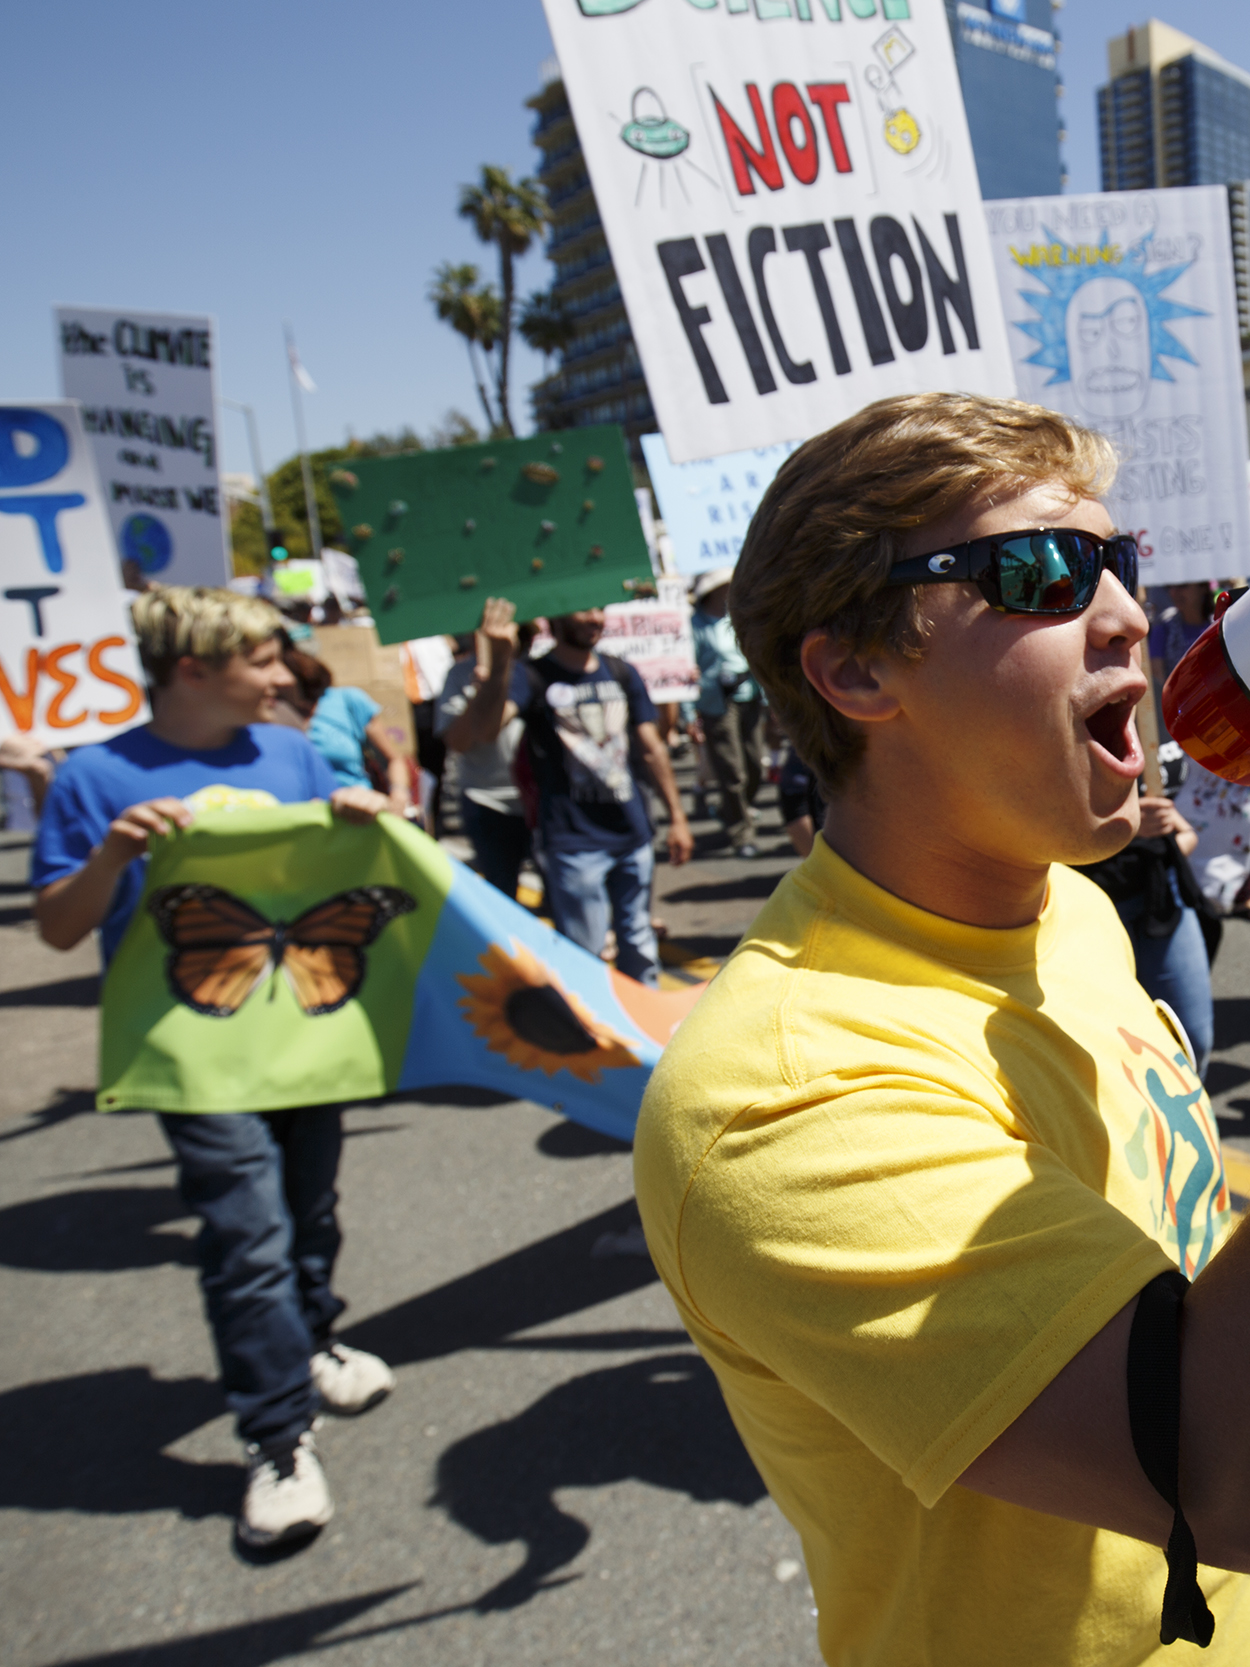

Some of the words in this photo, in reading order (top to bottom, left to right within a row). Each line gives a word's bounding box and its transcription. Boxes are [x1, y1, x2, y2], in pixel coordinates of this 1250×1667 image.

[708, 81, 853, 196] NOT
[1053, 201, 1127, 229] NEED
[1009, 243, 1123, 268] WARNING
[656, 212, 981, 404] FICTION
[80, 406, 216, 471] HANGING
